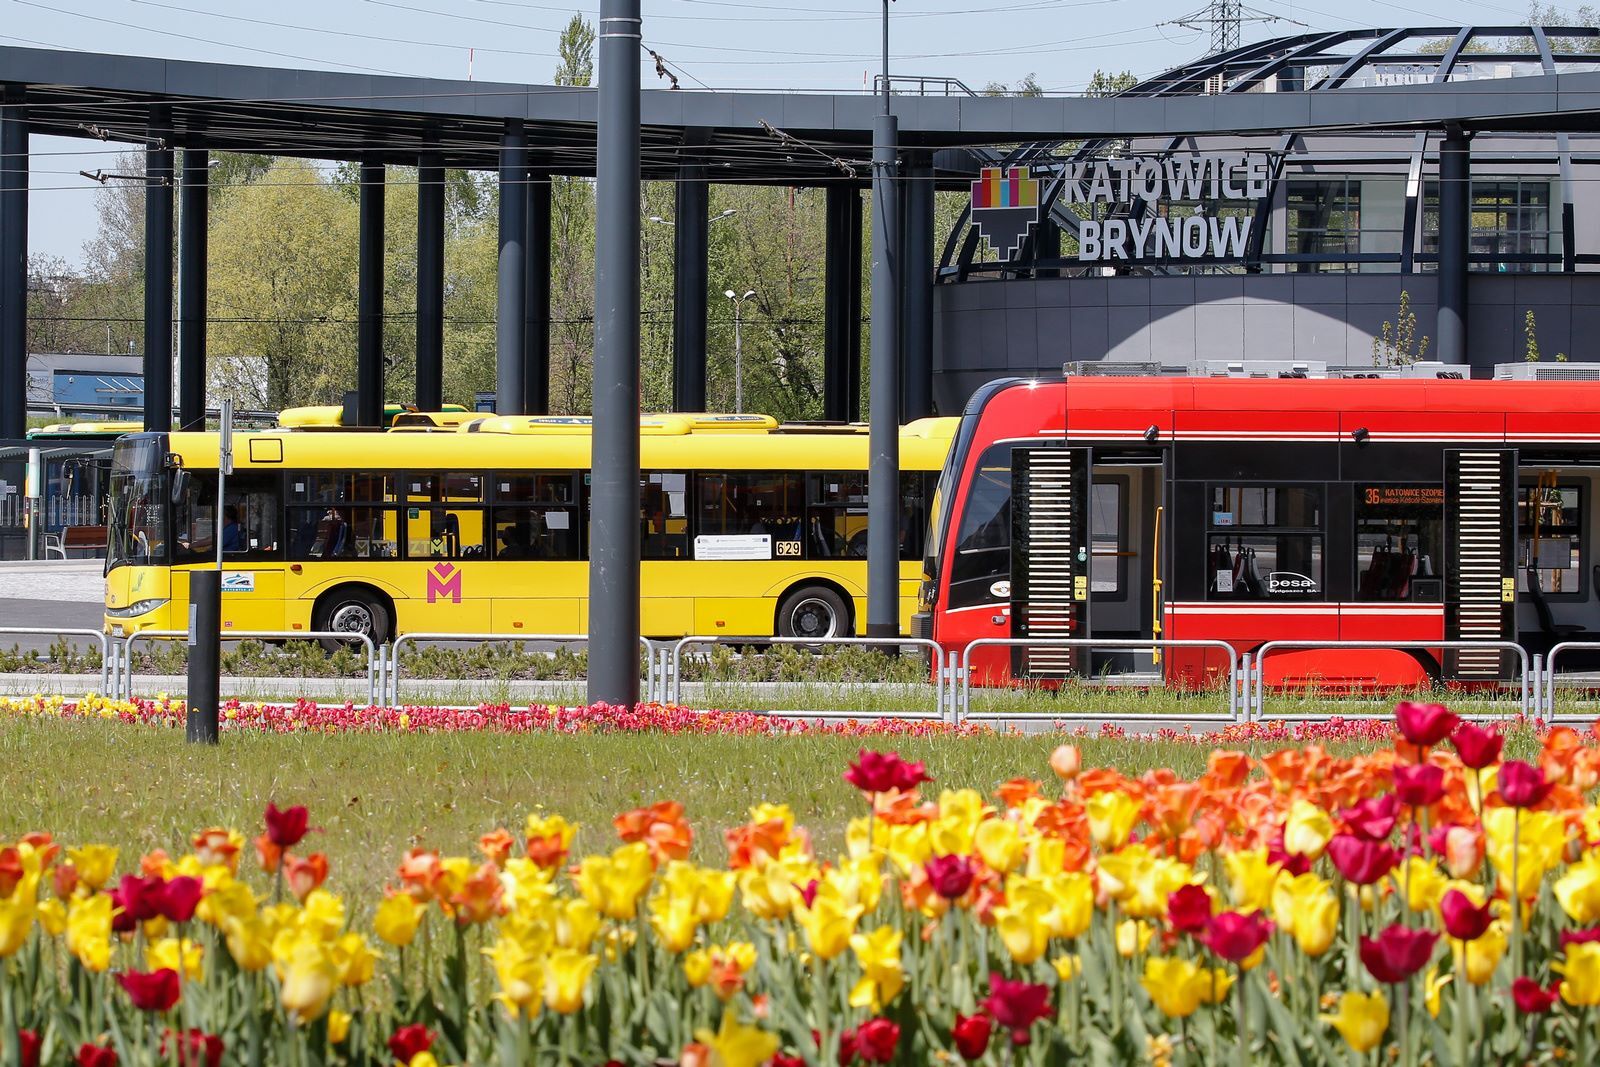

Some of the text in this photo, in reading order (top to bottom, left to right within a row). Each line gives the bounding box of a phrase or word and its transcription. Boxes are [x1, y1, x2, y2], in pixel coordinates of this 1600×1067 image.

[1064, 157, 1268, 203] KATOWICE
[1079, 204, 1252, 260] BRYNÓW
[1365, 489, 1380, 504] 36
[1421, 489, 1445, 497] SZOPIE
[777, 542, 800, 555] 629
[1270, 579, 1311, 589] pesa
